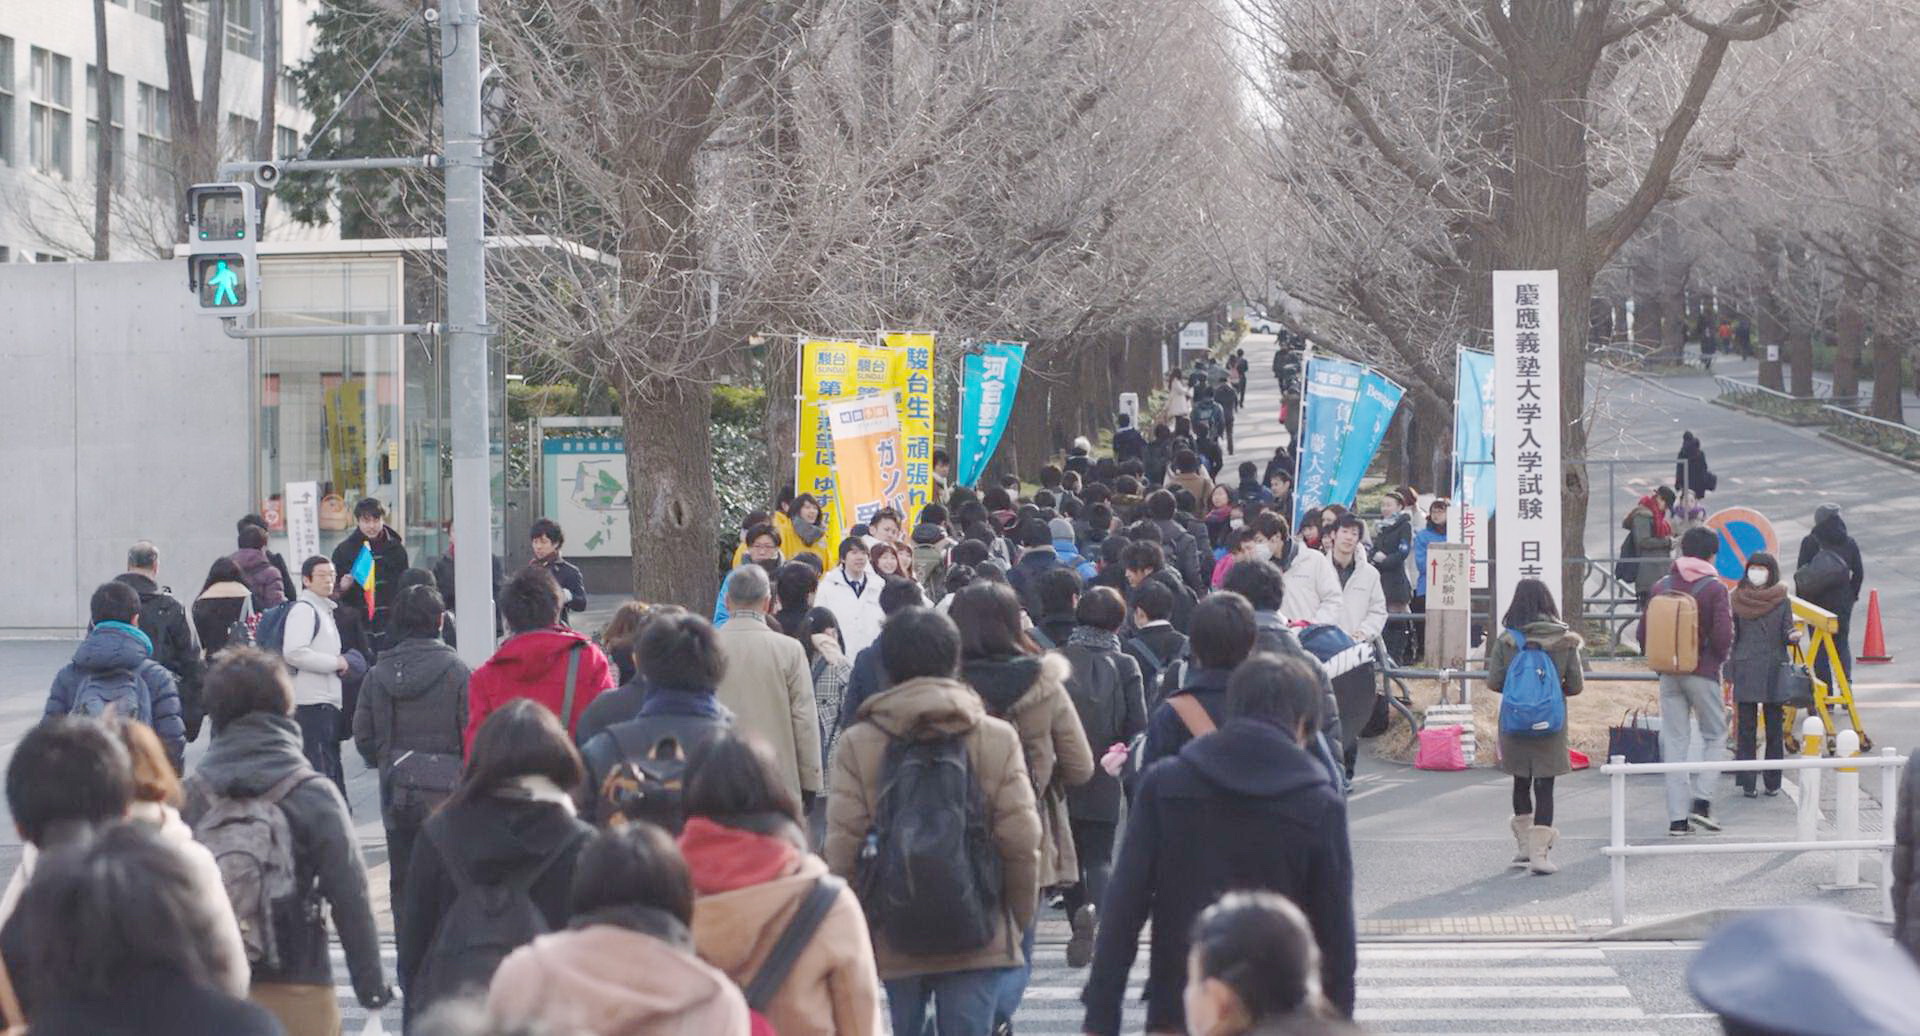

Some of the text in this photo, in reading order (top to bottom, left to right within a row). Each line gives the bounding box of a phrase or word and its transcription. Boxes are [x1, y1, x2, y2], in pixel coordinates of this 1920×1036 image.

[818, 352, 845, 366] 駿台
[857, 359, 884, 373] 駿台
[1515, 283, 1543, 519] 慶應義塾大学入学試験
[905, 347, 930, 525] 駿台生、頑張れ
[1442, 552, 1455, 606] 入学試験場
